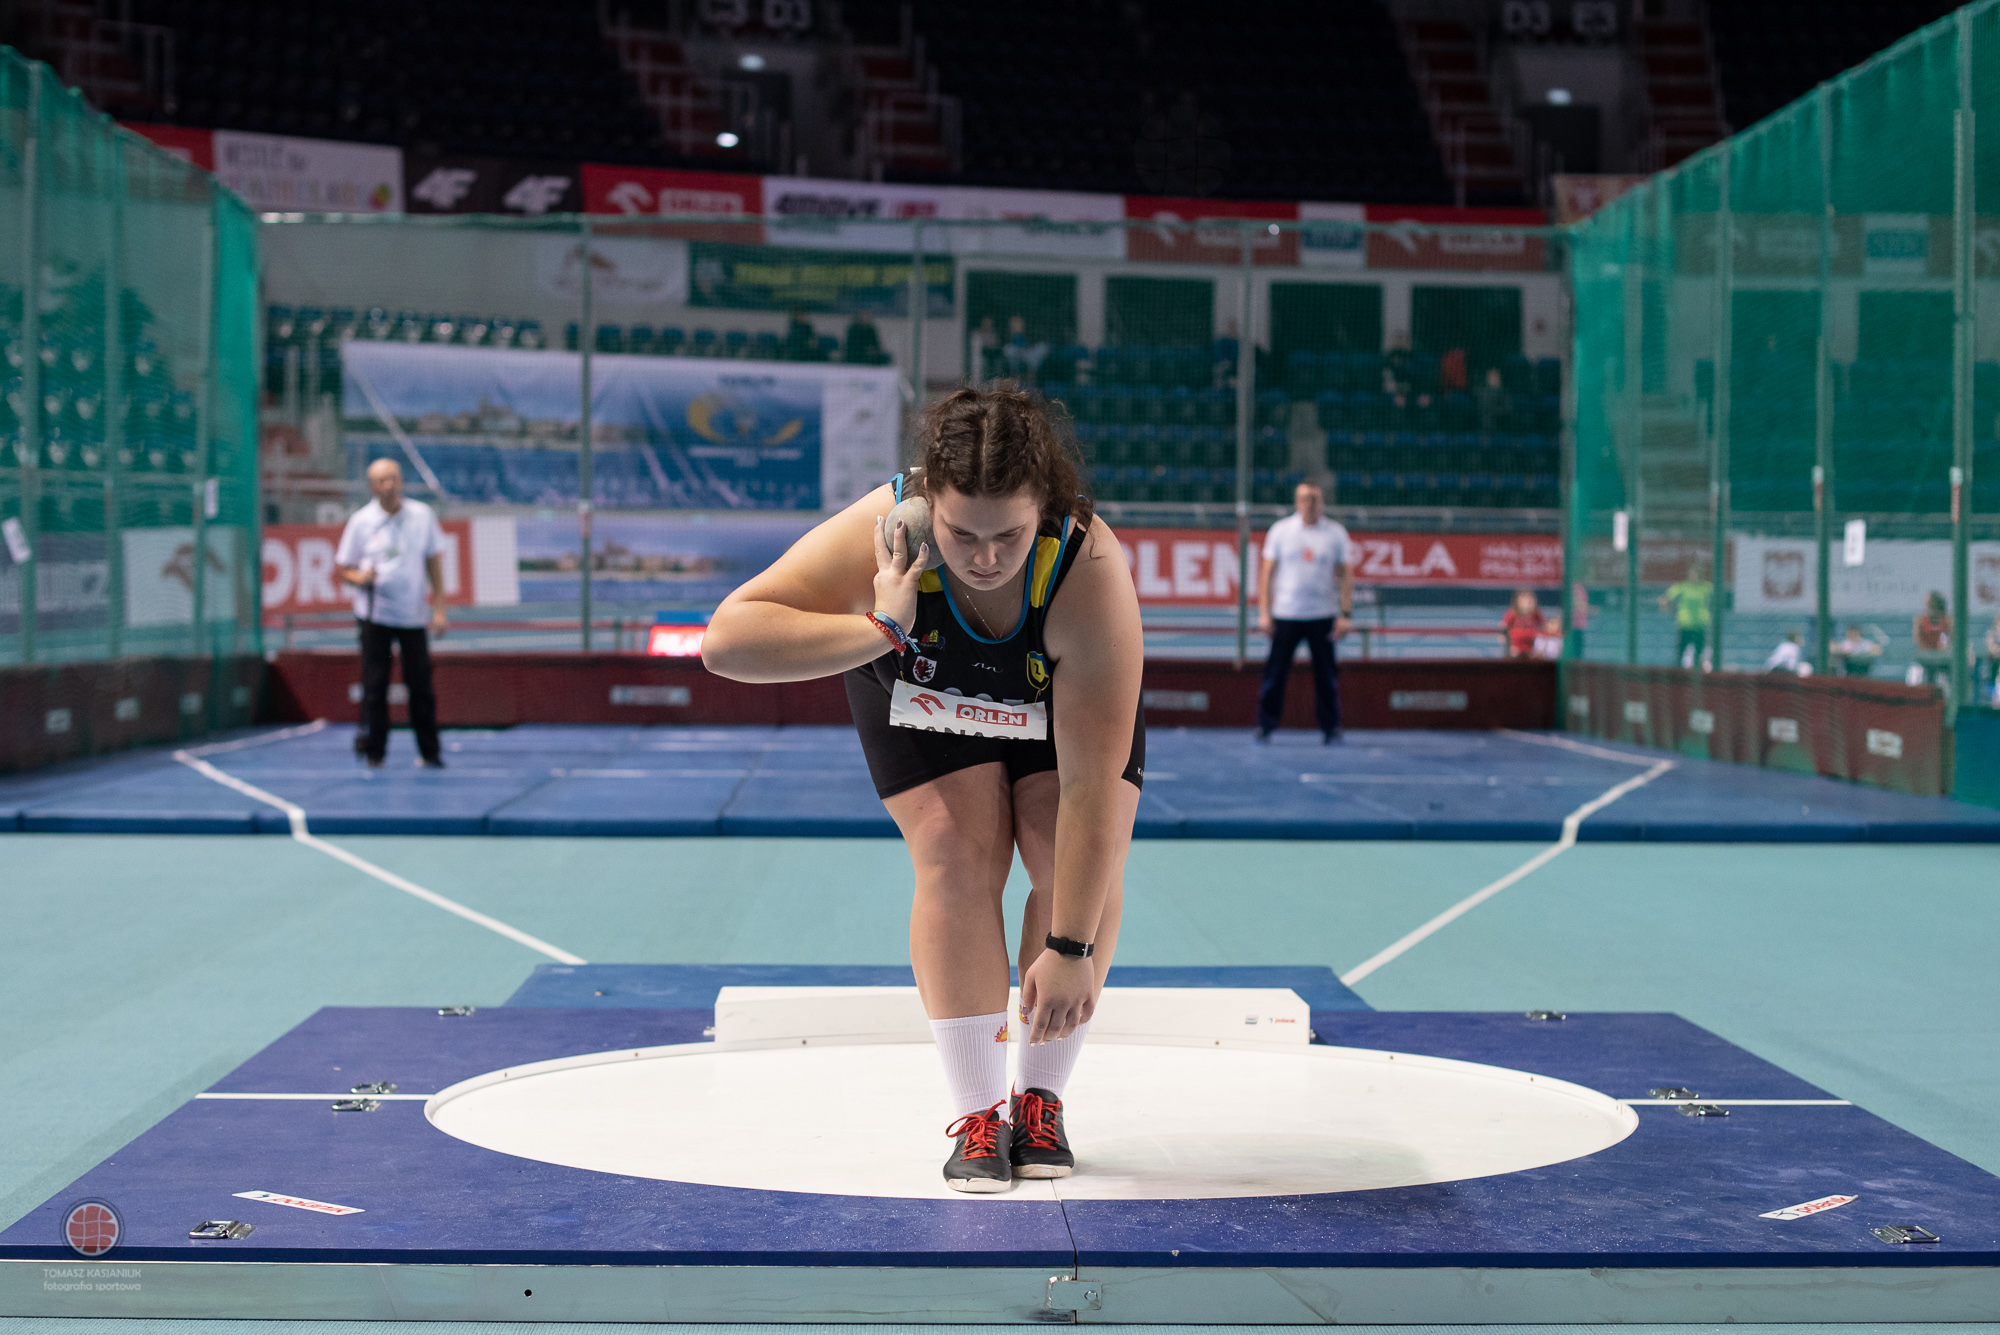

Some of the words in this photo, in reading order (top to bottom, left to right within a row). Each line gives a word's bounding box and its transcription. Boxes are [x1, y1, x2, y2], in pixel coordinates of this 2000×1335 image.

[412, 167, 477, 209] 4F
[503, 174, 571, 214] 4F
[959, 706, 1023, 725] ORLEN
